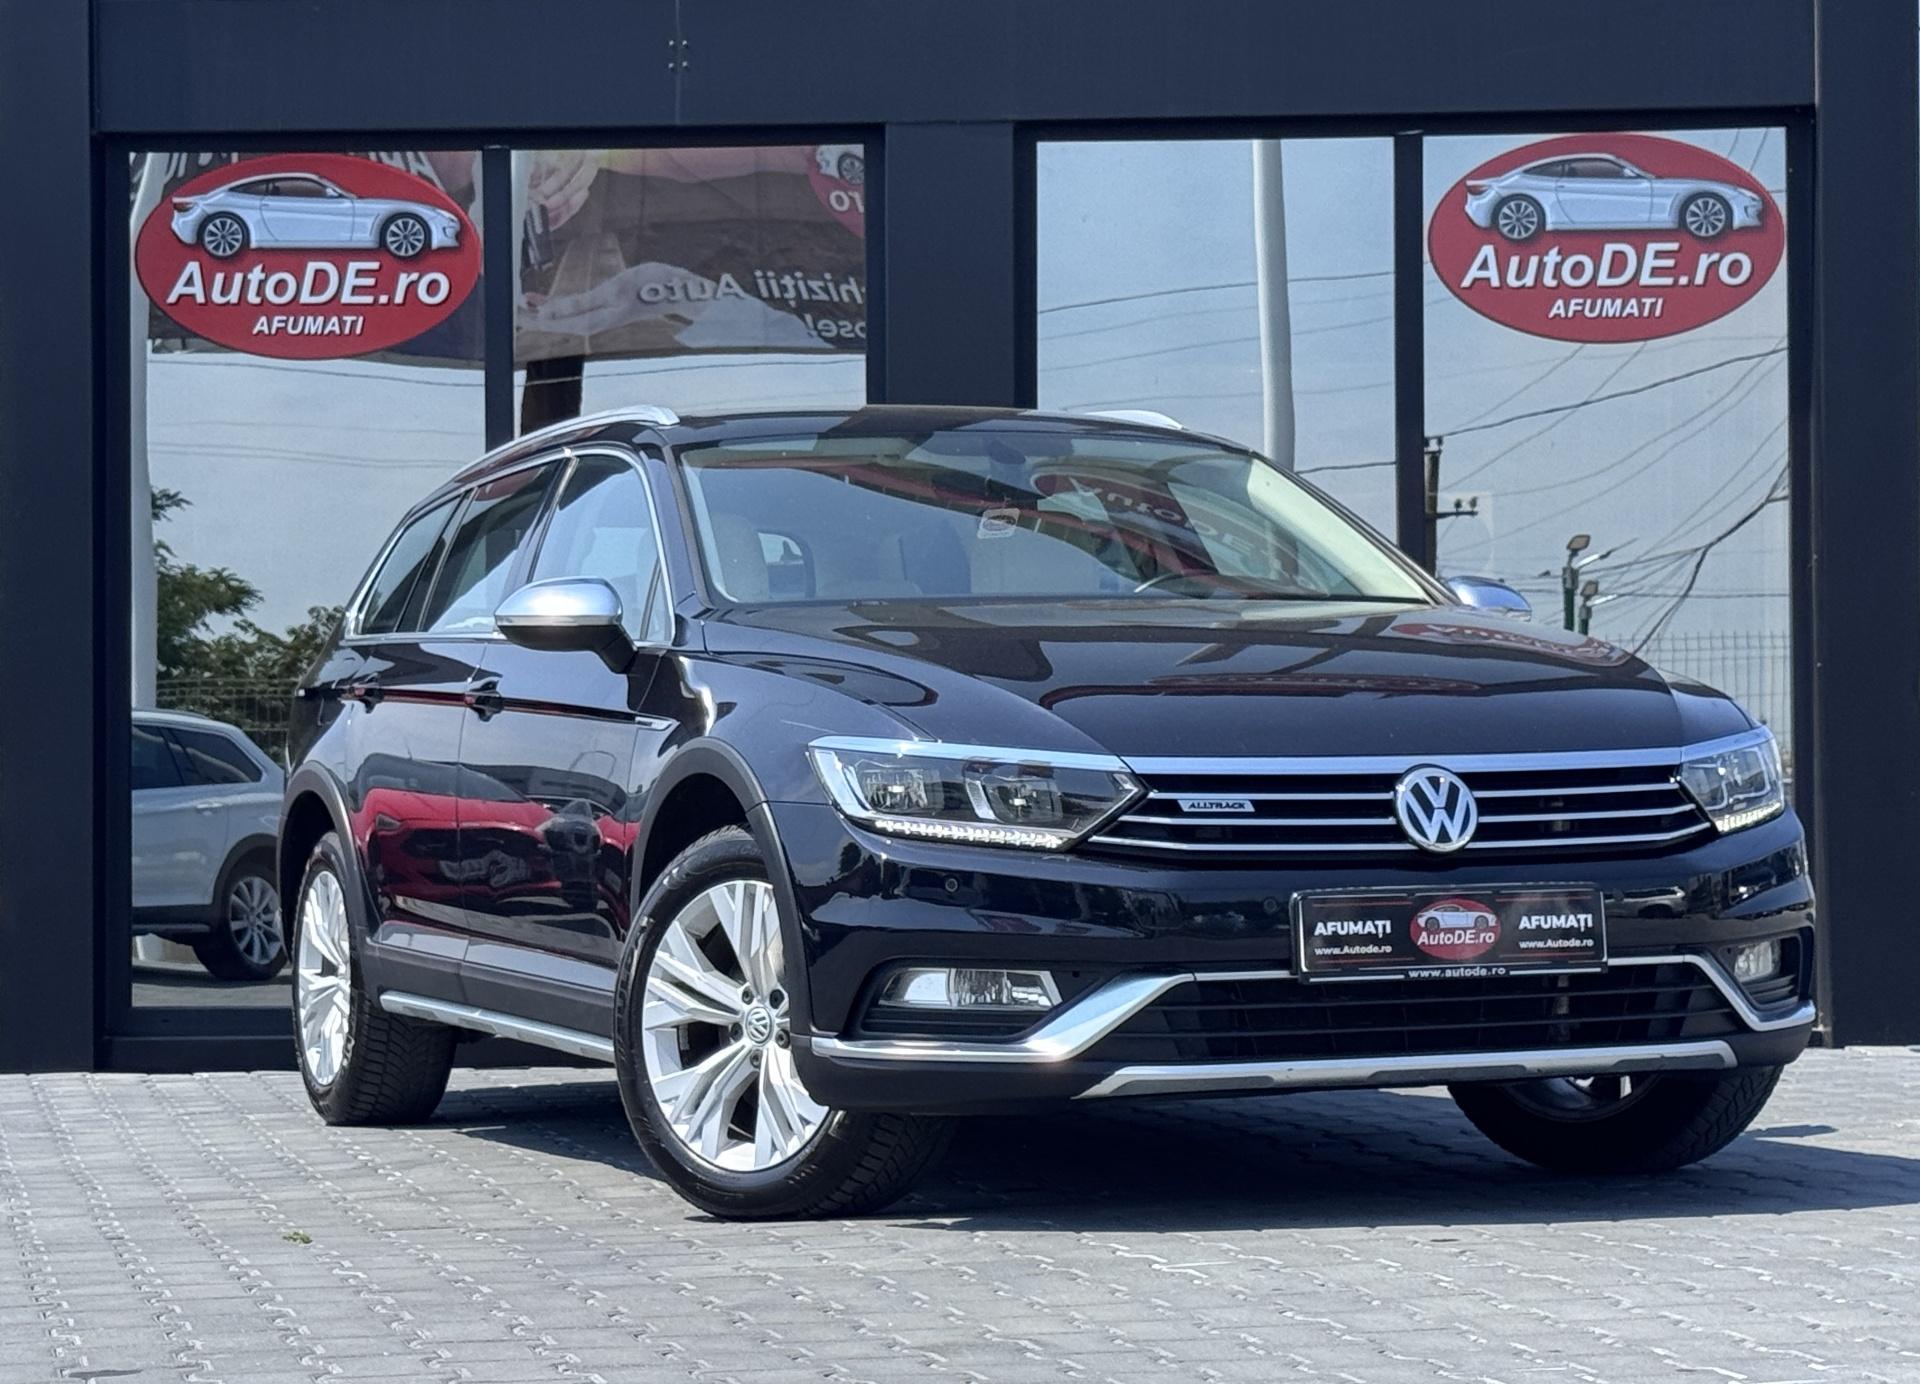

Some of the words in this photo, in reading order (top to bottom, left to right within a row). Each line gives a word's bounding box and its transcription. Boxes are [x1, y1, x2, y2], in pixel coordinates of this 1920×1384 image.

[1461, 241, 1753, 288] AutoDE.ro
[167, 261, 450, 305] AutoDE.ro
[1548, 296, 1664, 319] AFUMATI
[253, 316, 364, 335] AFUMATI
[1187, 801, 1246, 809] ALLTRACK
[1417, 930, 1495, 945] AutoDE.ro
[1519, 938, 1594, 948] www.Autode.ro
[1314, 944, 1392, 955] www.Autode.ro
[1408, 966, 1506, 977] www.autode.ro
